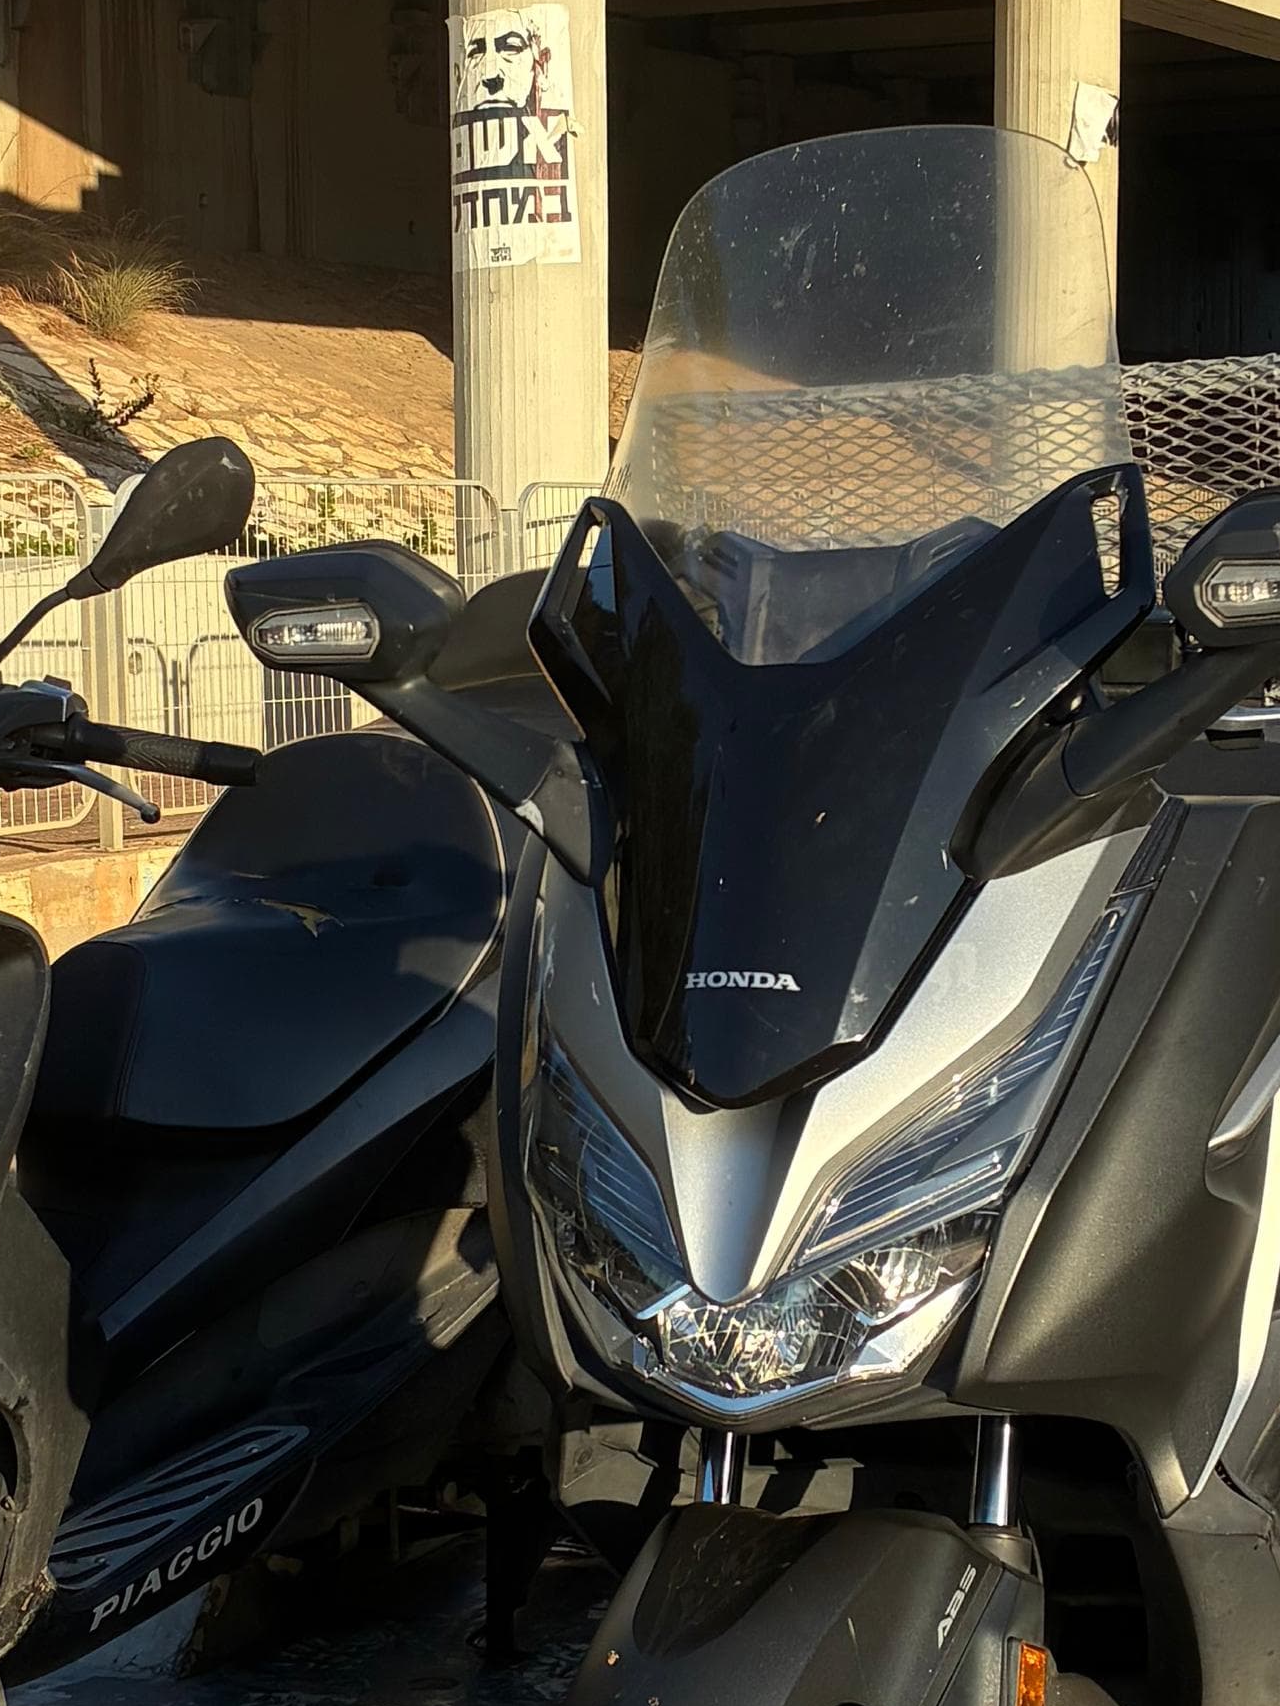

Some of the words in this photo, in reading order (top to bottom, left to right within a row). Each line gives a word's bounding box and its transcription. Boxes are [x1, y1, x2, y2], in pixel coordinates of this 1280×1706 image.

[685, 971, 801, 992] HONDA
[89, 1497, 264, 1633] PIAGGIO
[937, 1563, 977, 1649] ABS
